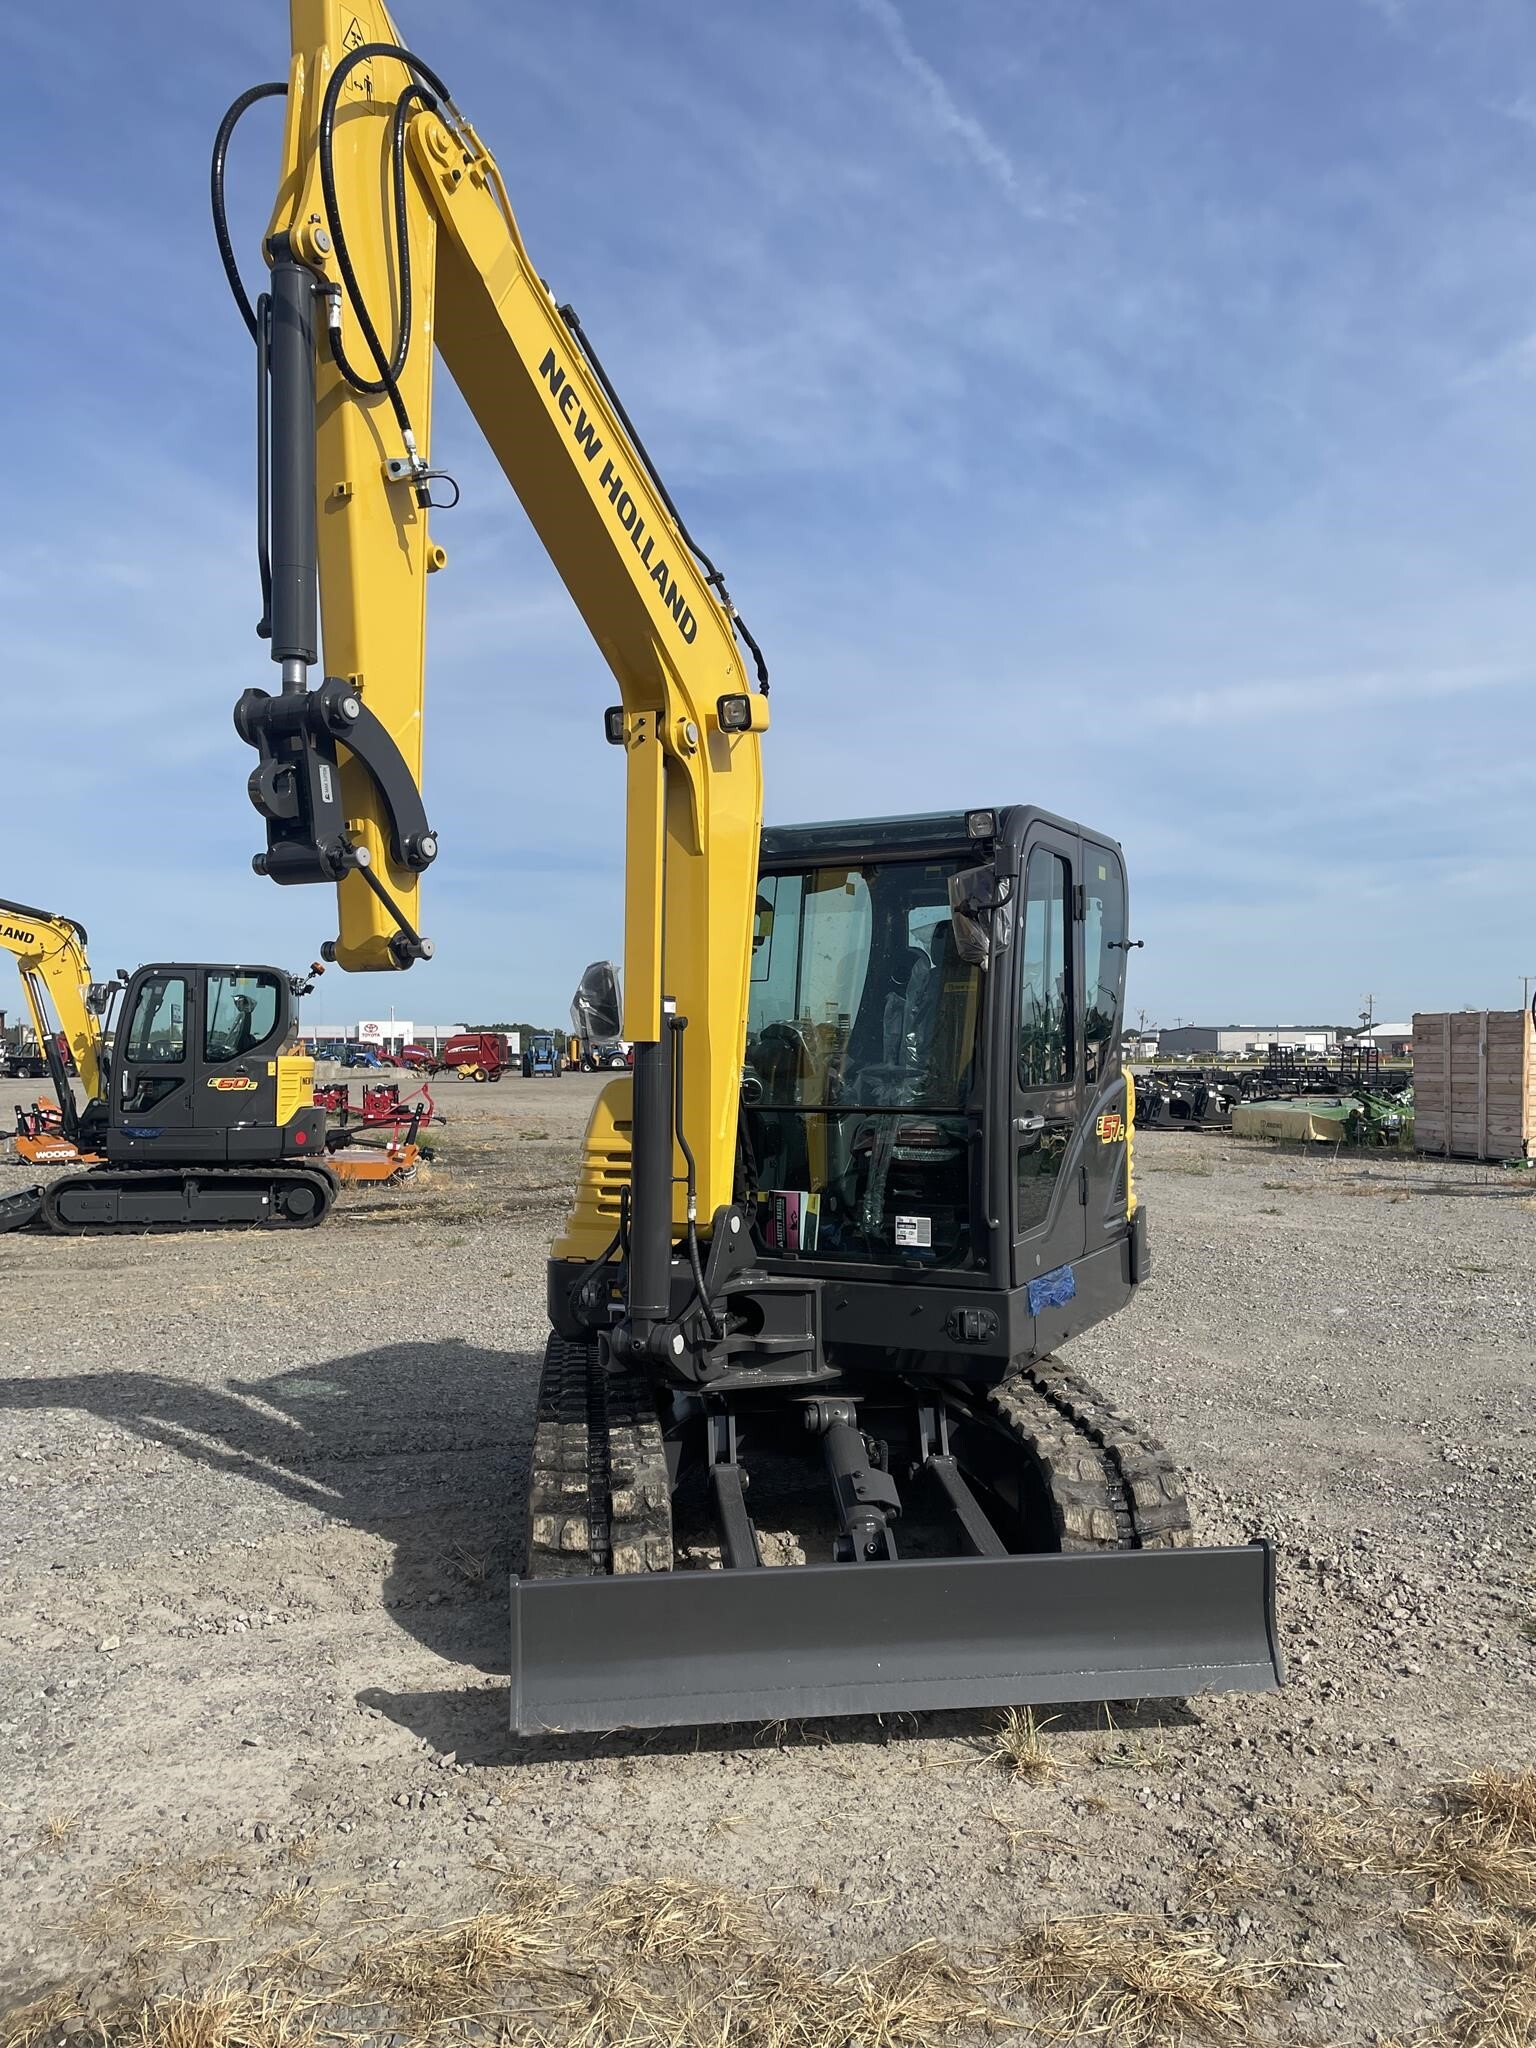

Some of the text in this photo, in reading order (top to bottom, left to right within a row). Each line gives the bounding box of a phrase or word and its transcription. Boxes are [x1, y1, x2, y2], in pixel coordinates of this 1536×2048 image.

[538, 347, 698, 645] NEW HOLLAND
[35, 1150, 76, 1159] WOODS
[775, 1198, 783, 1220] MANUAL
